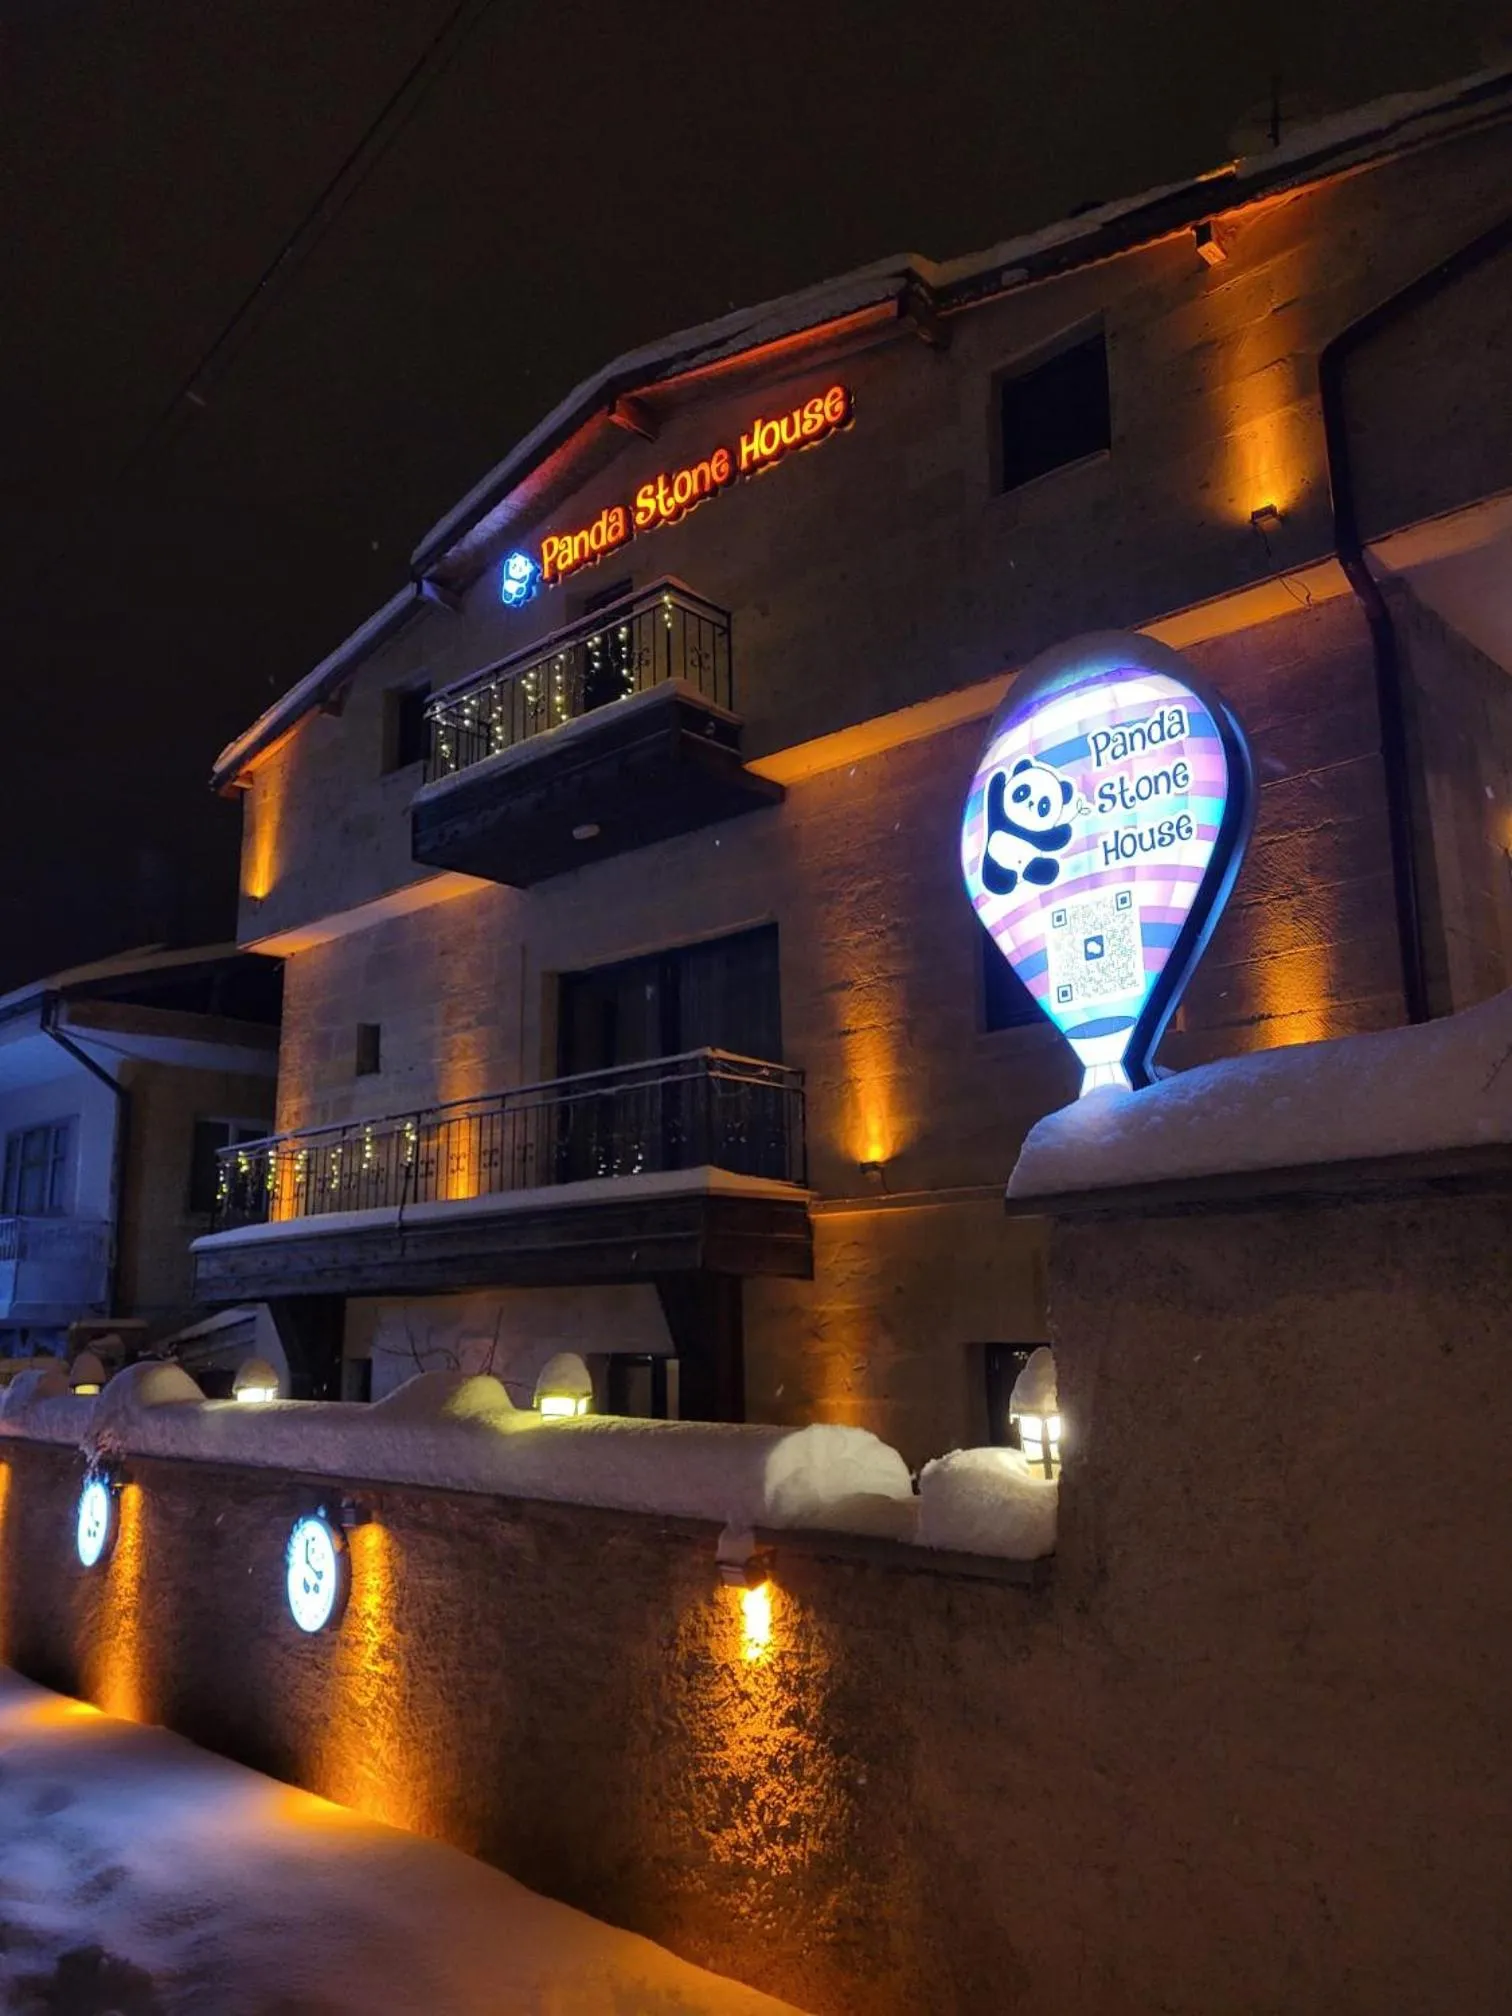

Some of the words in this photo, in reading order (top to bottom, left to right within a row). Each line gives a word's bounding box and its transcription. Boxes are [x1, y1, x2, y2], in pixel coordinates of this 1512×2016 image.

[542, 507, 628, 580] Panda
[635, 448, 730, 526] Stone
[740, 386, 846, 469] House
[1091, 708, 1186, 768] Panda
[1097, 762, 1190, 814] Stone
[1102, 814, 1193, 866] House
